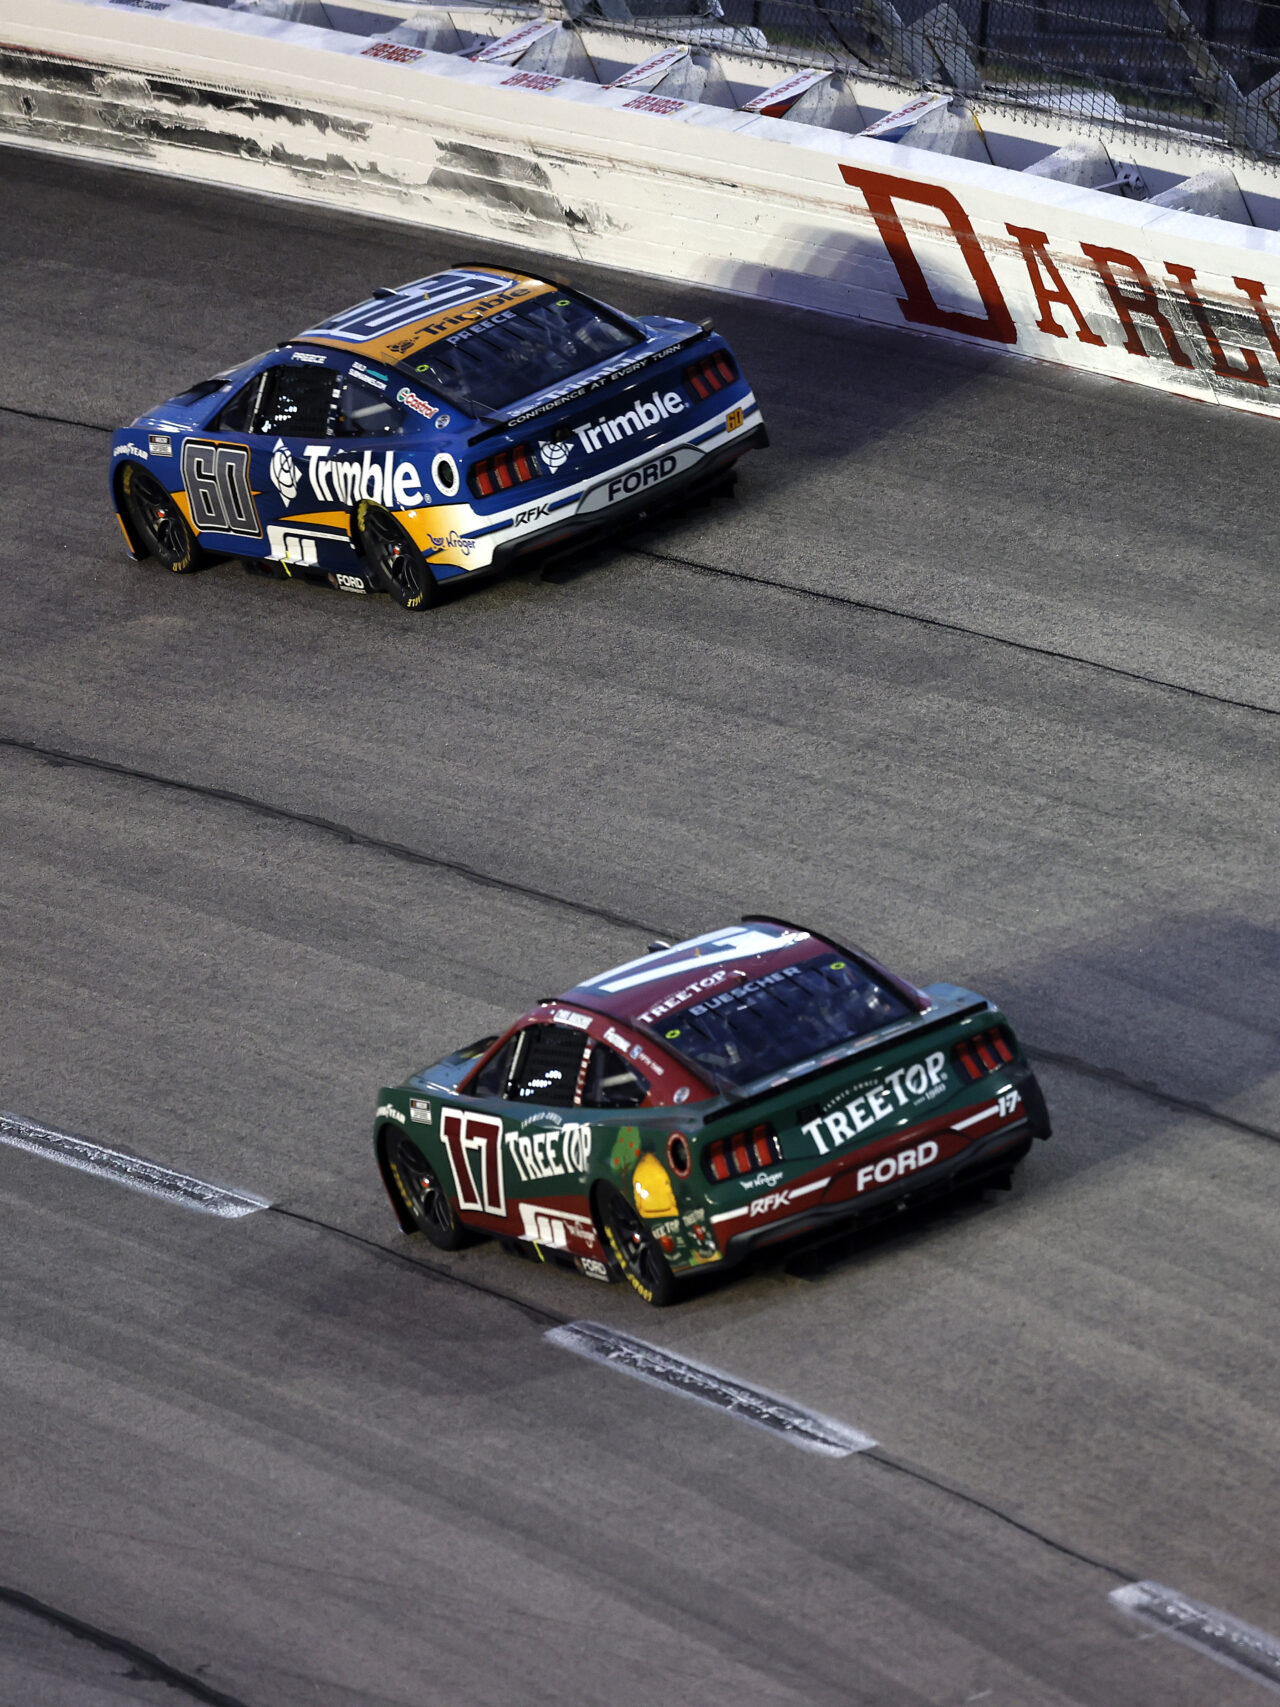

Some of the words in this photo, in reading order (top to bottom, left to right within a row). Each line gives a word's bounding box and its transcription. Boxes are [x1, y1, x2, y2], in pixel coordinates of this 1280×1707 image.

[446, 309, 517, 345] PREECE
[405, 392, 439, 420] Castrol
[507, 388, 587, 428] CONFIDENCE
[590, 378, 607, 391] AT
[611, 358, 648, 381] EVERY
[652, 343, 682, 361] TURN
[572, 390, 687, 455] Trimble
[181, 437, 264, 540] 60
[303, 445, 424, 509] Trimble
[608, 455, 677, 502] FORD
[514, 503, 550, 528] RFK
[445, 531, 477, 556] Kroger
[336, 573, 365, 589] FORD
[688, 966, 802, 1017] BUESCHER
[998, 1089, 1021, 1117] 17
[440, 1106, 507, 1218] 17
[856, 1140, 939, 1191] FORD
[750, 1189, 790, 1217] RFK
[581, 1257, 607, 1276] FORD
